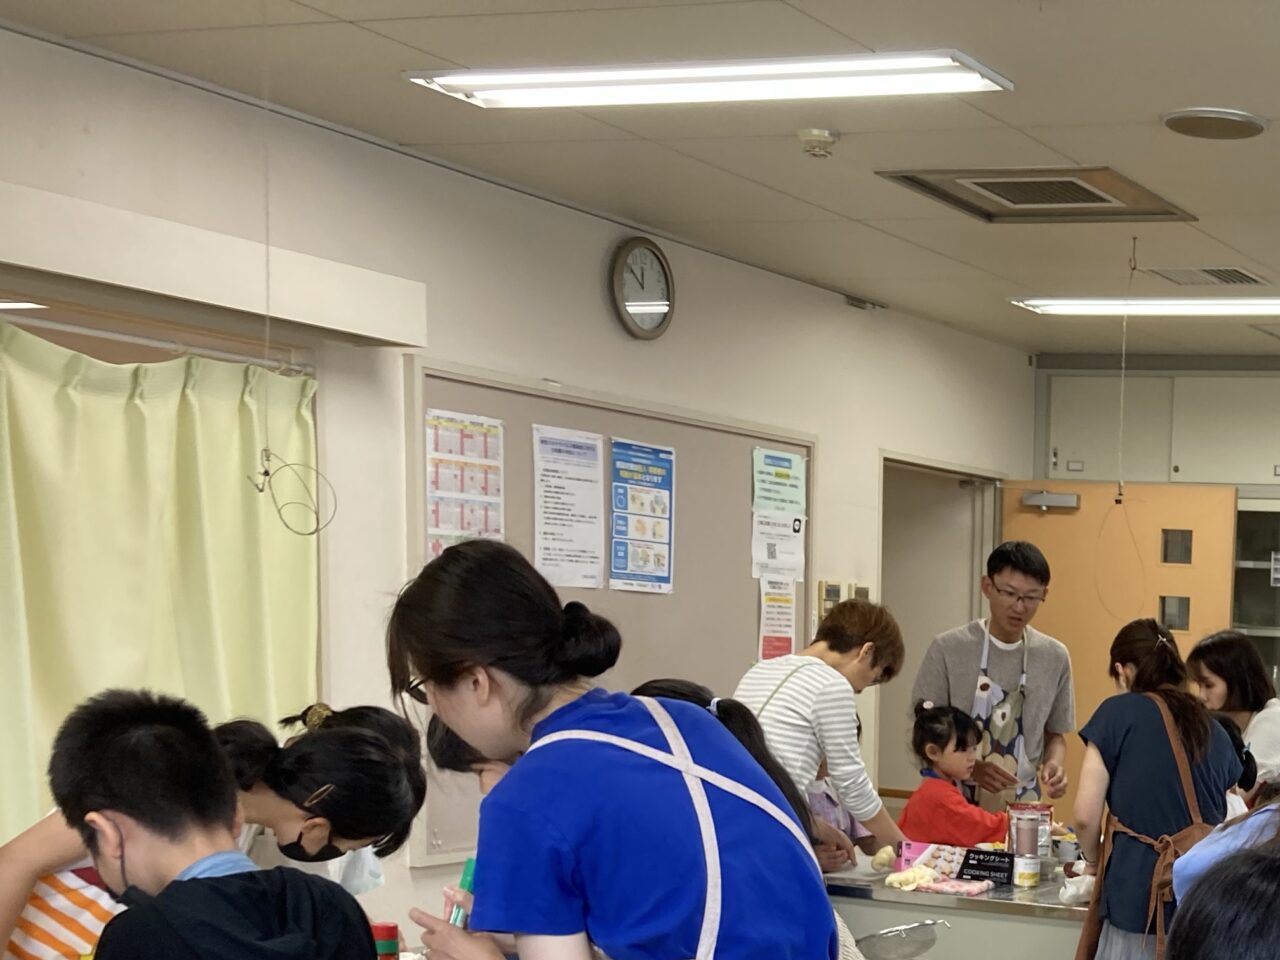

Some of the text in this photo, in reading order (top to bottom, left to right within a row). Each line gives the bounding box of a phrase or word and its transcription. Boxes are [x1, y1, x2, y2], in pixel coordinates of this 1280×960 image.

[969, 853, 1010, 862] クッキングシート
